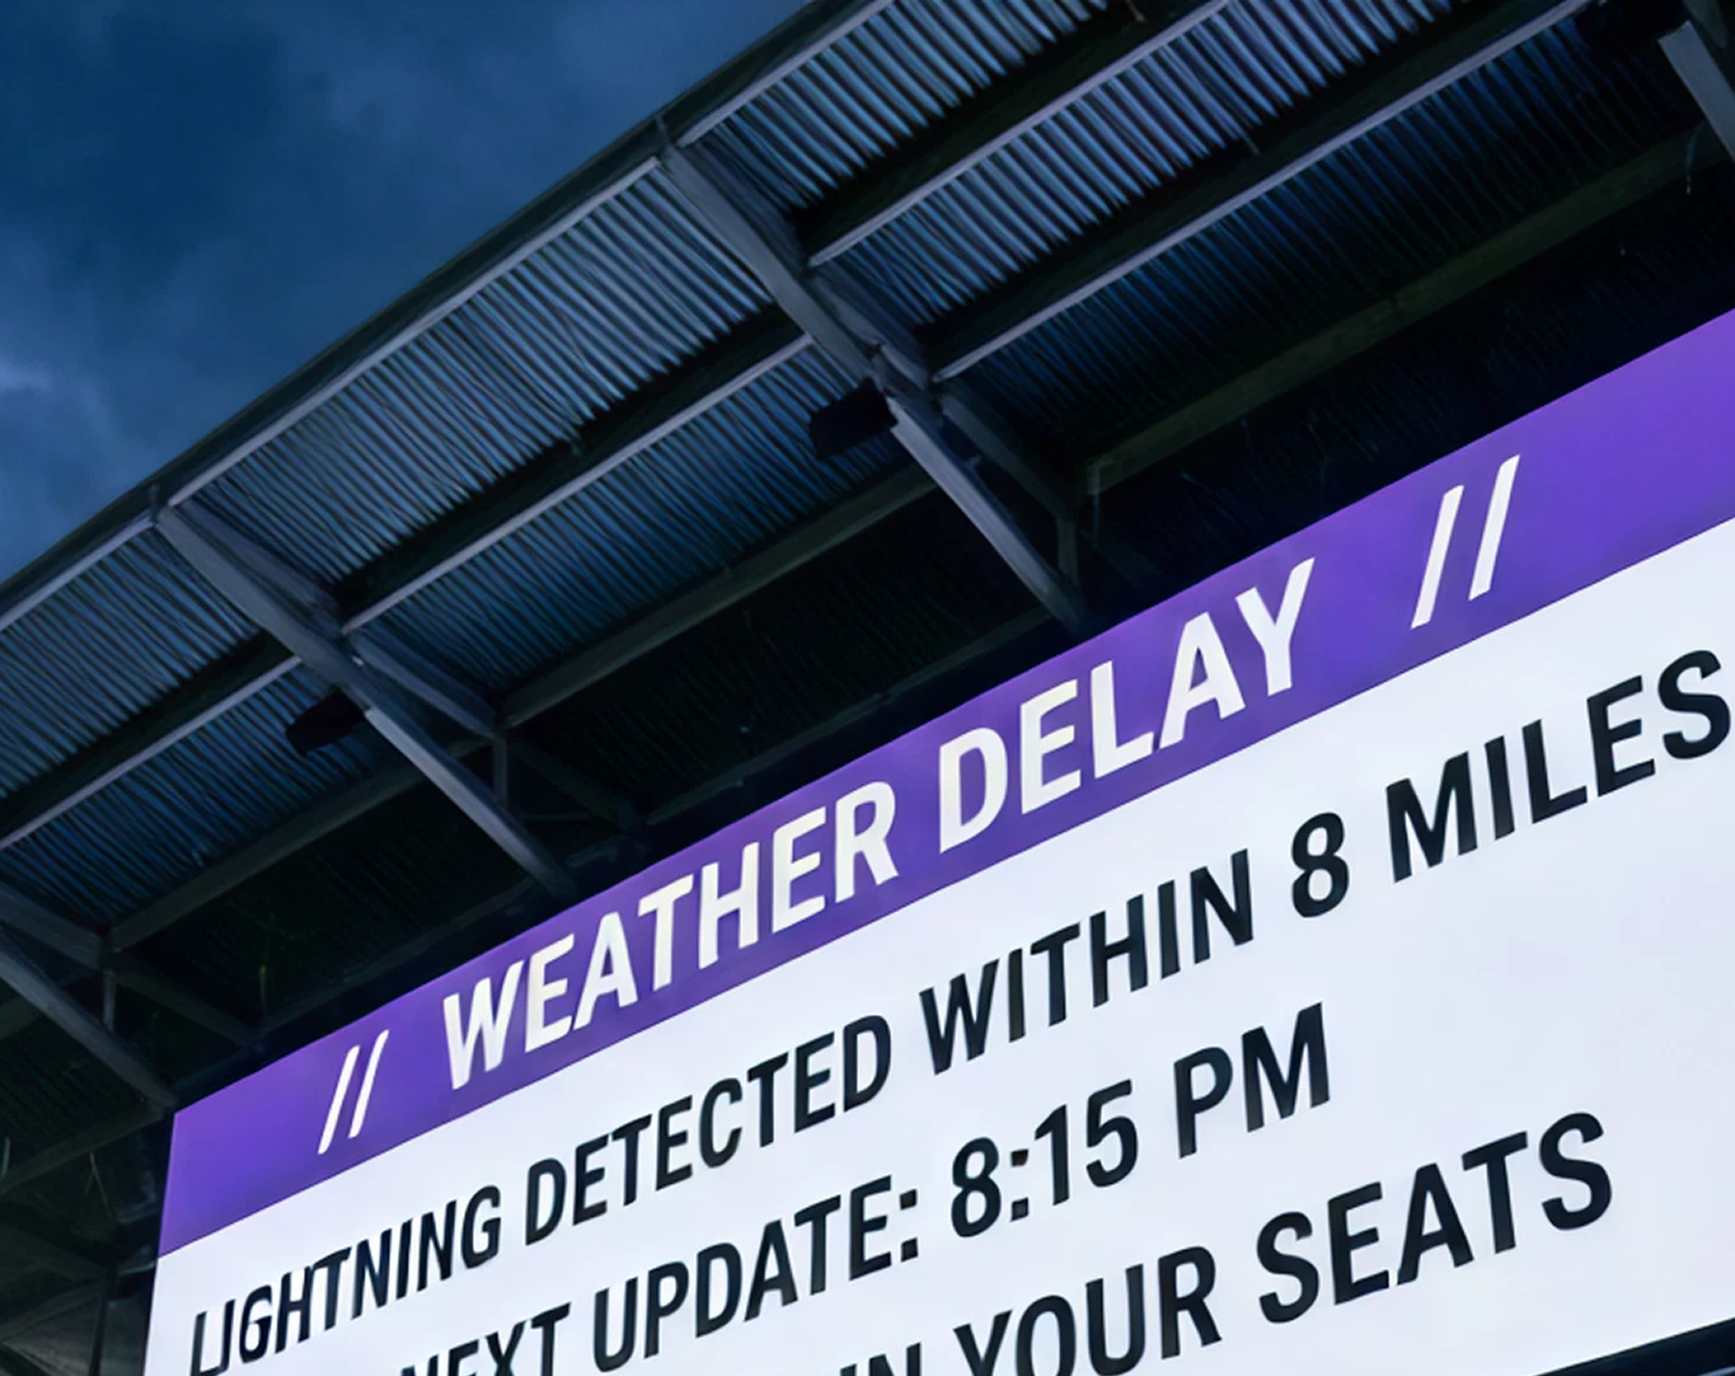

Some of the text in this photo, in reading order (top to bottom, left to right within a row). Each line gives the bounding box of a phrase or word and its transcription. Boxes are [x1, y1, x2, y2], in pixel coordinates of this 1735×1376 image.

[443, 781, 899, 1090] WEATHER
[939, 557, 1315, 854] DELAY
[525, 1015, 892, 1246] DETECTED
[918, 848, 1254, 1075] WITHIN
[1291, 812, 1350, 918] 8
[1385, 650, 1731, 883] MILES
[593, 1174, 919, 1373] UPDATE:
[951, 1079, 1138, 1238] 8:15
[1173, 1002, 1330, 1159] PM
[1256, 1112, 1612, 1324] SEATS
